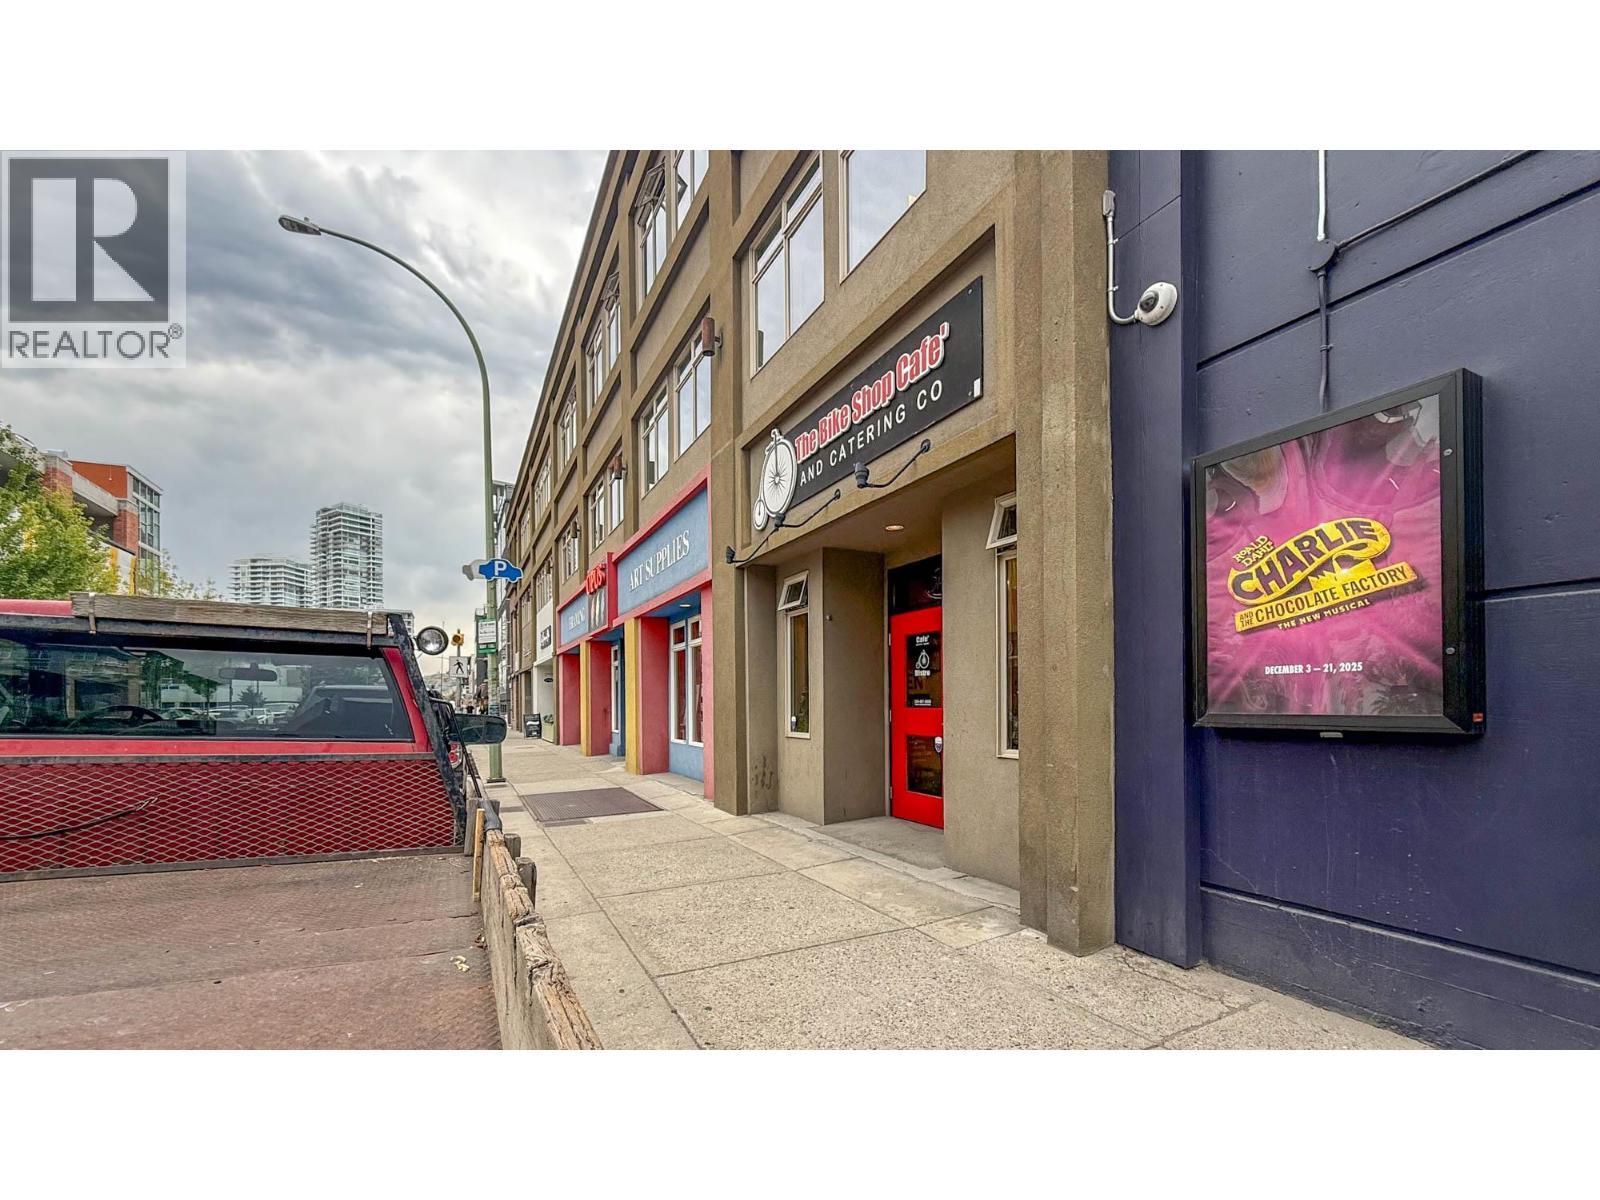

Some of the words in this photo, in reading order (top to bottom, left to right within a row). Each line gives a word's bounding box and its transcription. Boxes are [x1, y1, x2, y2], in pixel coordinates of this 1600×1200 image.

[795, 429, 819, 464] The
[818, 404, 851, 449] Bike
[851, 370, 895, 424] Shop
[800, 459, 823, 486] AND
[829, 404, 906, 467] CATERING
[916, 379, 942, 410] CO
[629, 563, 644, 592] ART
[645, 529, 690, 581] SUPPLIES
[1231, 519, 1380, 600] CHARLIE
[1232, 535, 1269, 563] ROALD
[494, 560, 508, 576] P
[1255, 586, 1340, 623] CHOCOLATE
[1341, 565, 1409, 597] FACTORY
[1239, 611, 1254, 621] AND
[1240, 617, 1254, 628] THE
[1278, 619, 1297, 630] THE
[1299, 612, 1321, 626] NEW
[1323, 598, 1371, 617] MUSICAL
[1264, 664, 1304, 675] DECEMBER
[1305, 663, 1312, 673] 3
[1323, 663, 1337, 674] 21,
[1339, 661, 1363, 672] 2025
